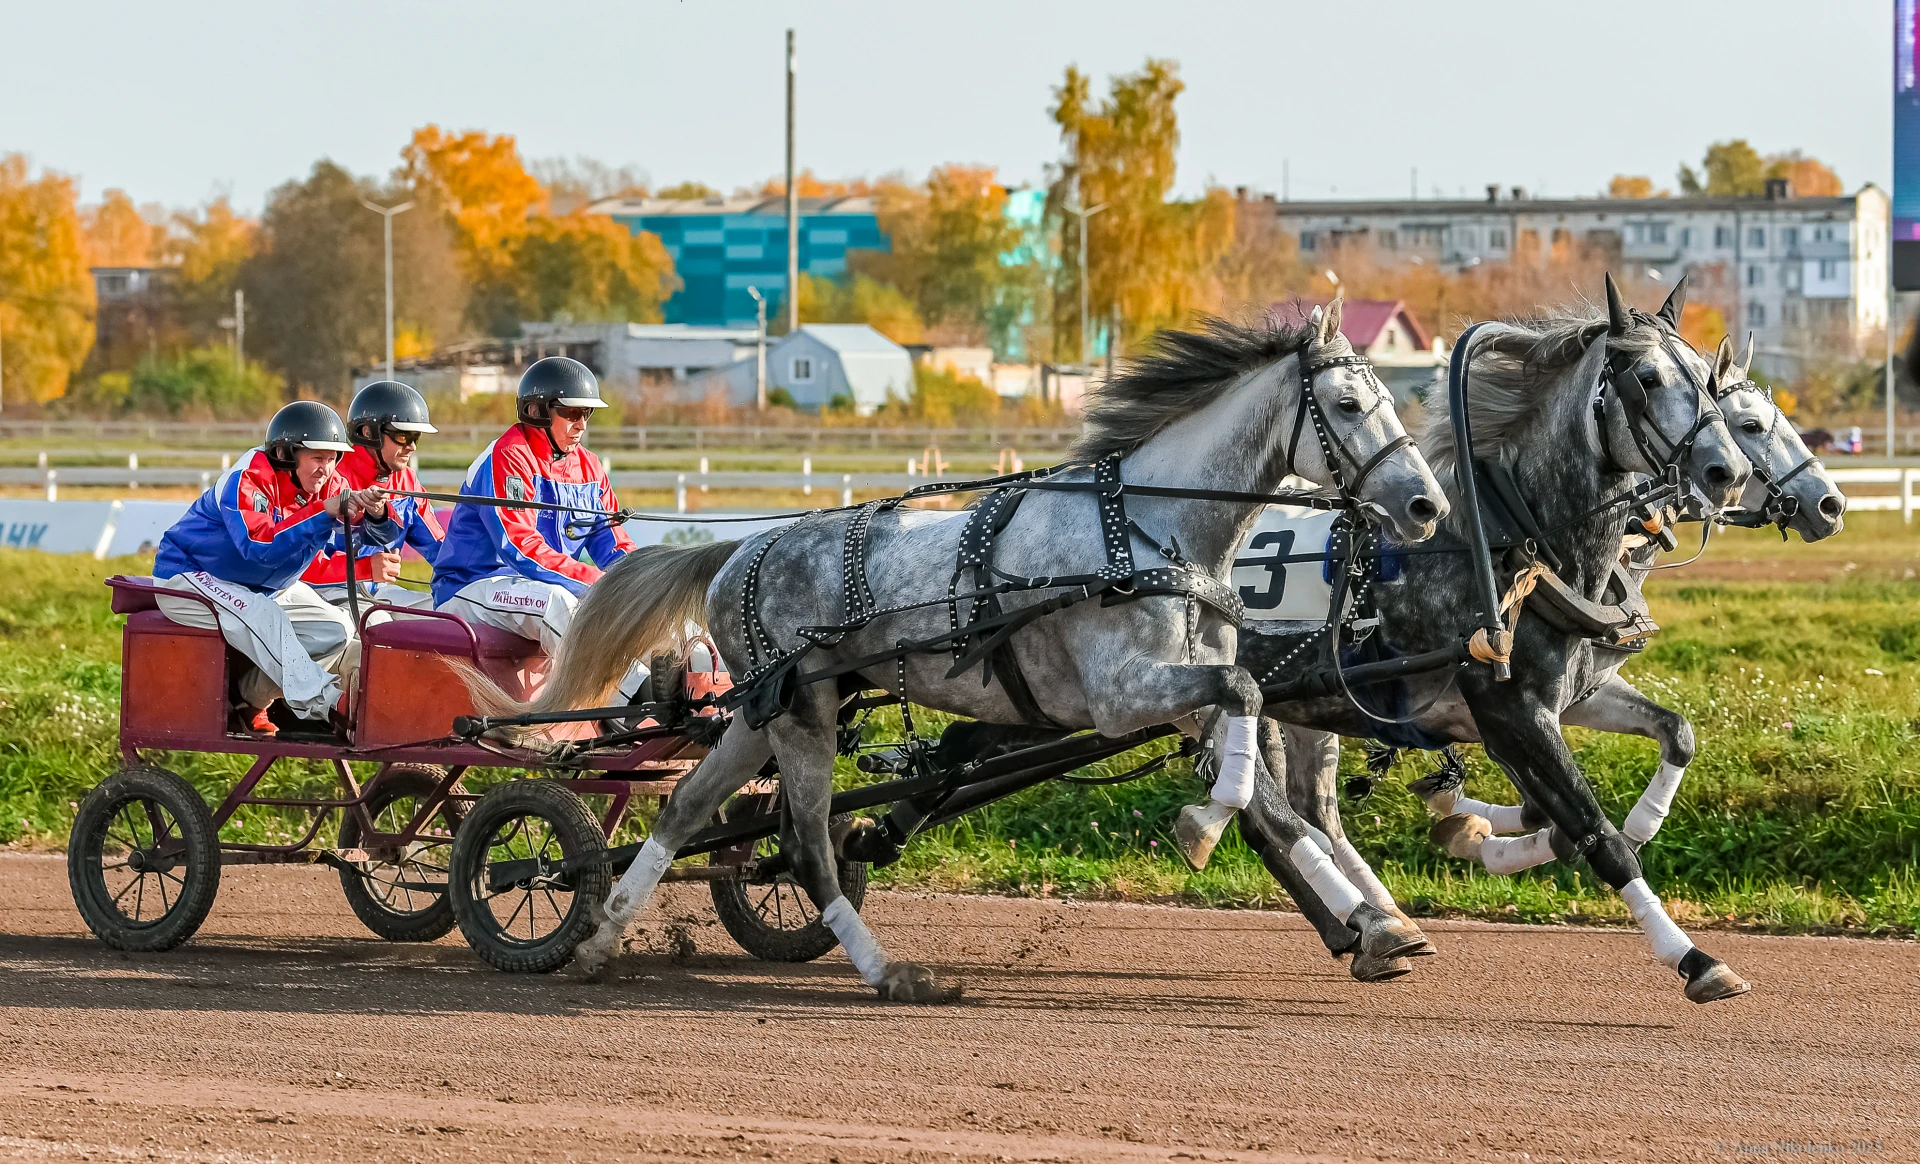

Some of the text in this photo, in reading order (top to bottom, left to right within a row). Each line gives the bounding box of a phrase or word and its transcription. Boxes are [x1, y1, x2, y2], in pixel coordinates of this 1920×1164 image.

[0, 522, 48, 548] НК
[1239, 529, 1296, 610] 3
[233, 598, 248, 611] OY
[535, 599, 547, 609] OY
